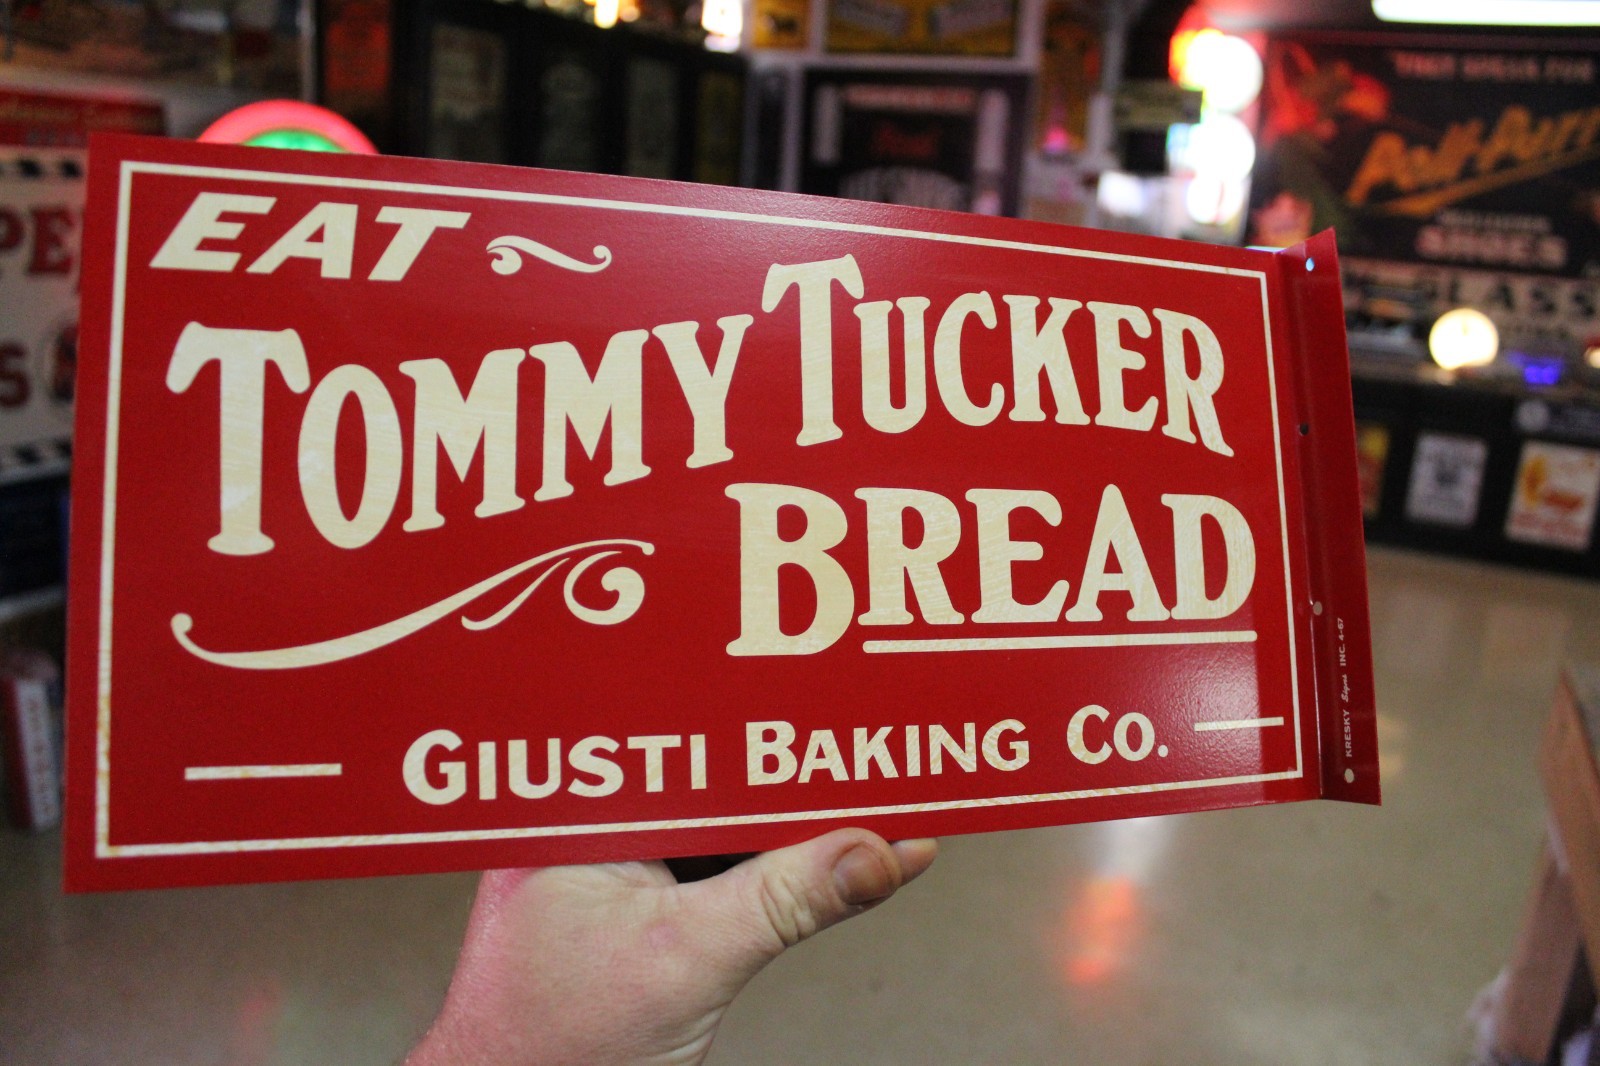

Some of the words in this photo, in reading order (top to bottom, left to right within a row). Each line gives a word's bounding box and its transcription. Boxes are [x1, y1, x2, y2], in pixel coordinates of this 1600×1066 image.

[150, 192, 471, 281] EAT
[166, 314, 754, 556] TOMMY
[761, 253, 1234, 457] TUCKER
[725, 483, 1255, 656] BREAD
[1340, 673, 1351, 703] Signs
[403, 730, 707, 806] GIUSTI
[746, 719, 1030, 786] BAKING
[1343, 709, 1353, 758] KRESKY
